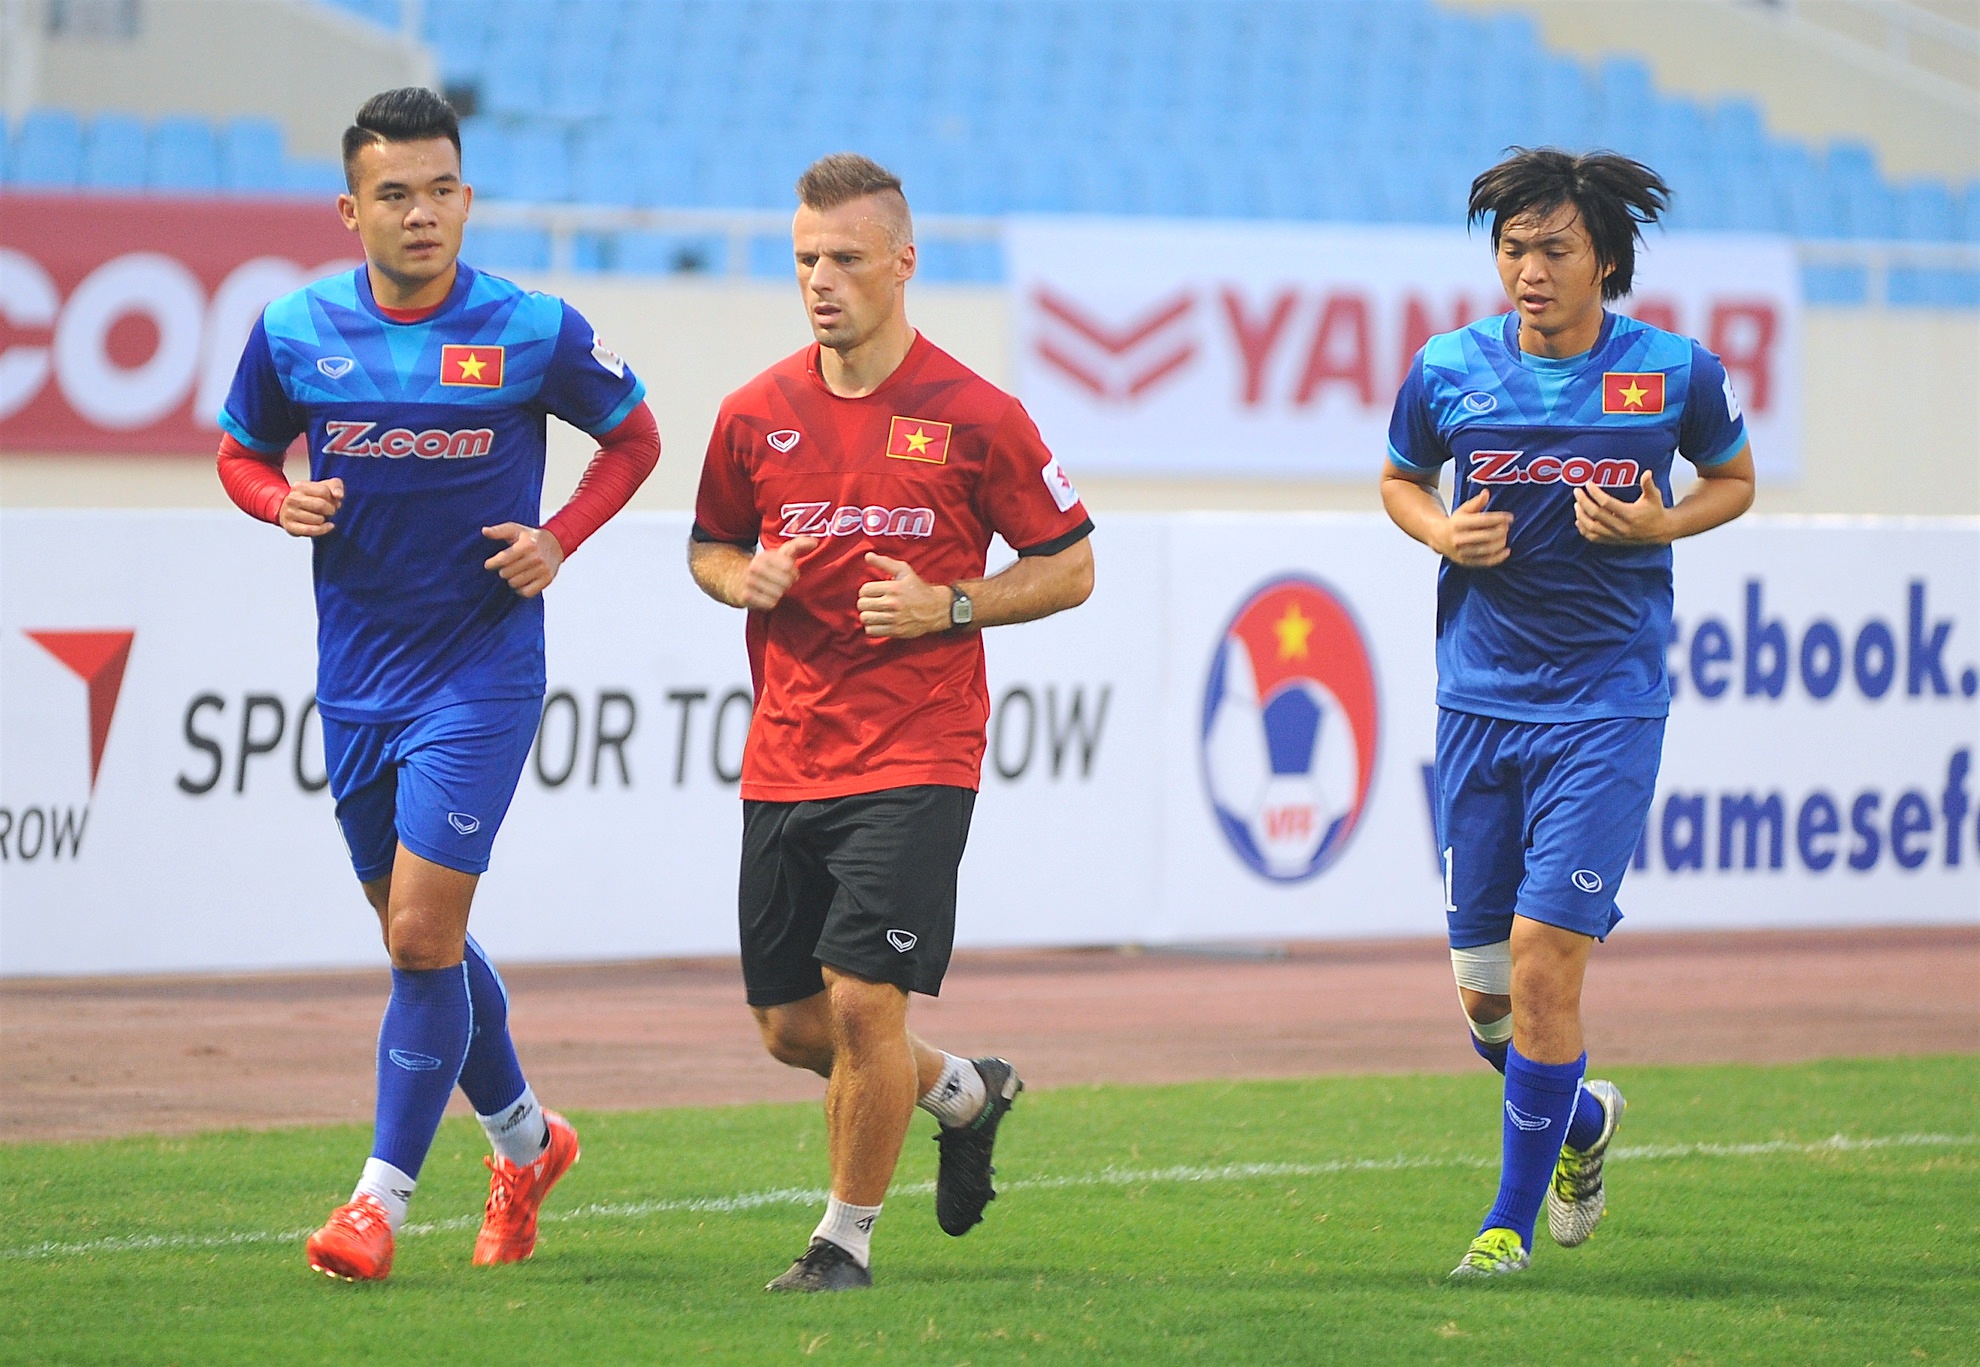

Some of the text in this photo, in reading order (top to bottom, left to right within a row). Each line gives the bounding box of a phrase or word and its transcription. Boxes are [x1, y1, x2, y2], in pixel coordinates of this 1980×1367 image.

[322, 421, 494, 459] Z.com
[1467, 450, 1639, 487] Z.com
[779, 501, 935, 538] Z.com
[177, 693, 329, 794] SPO
[536, 690, 636, 787] OR
